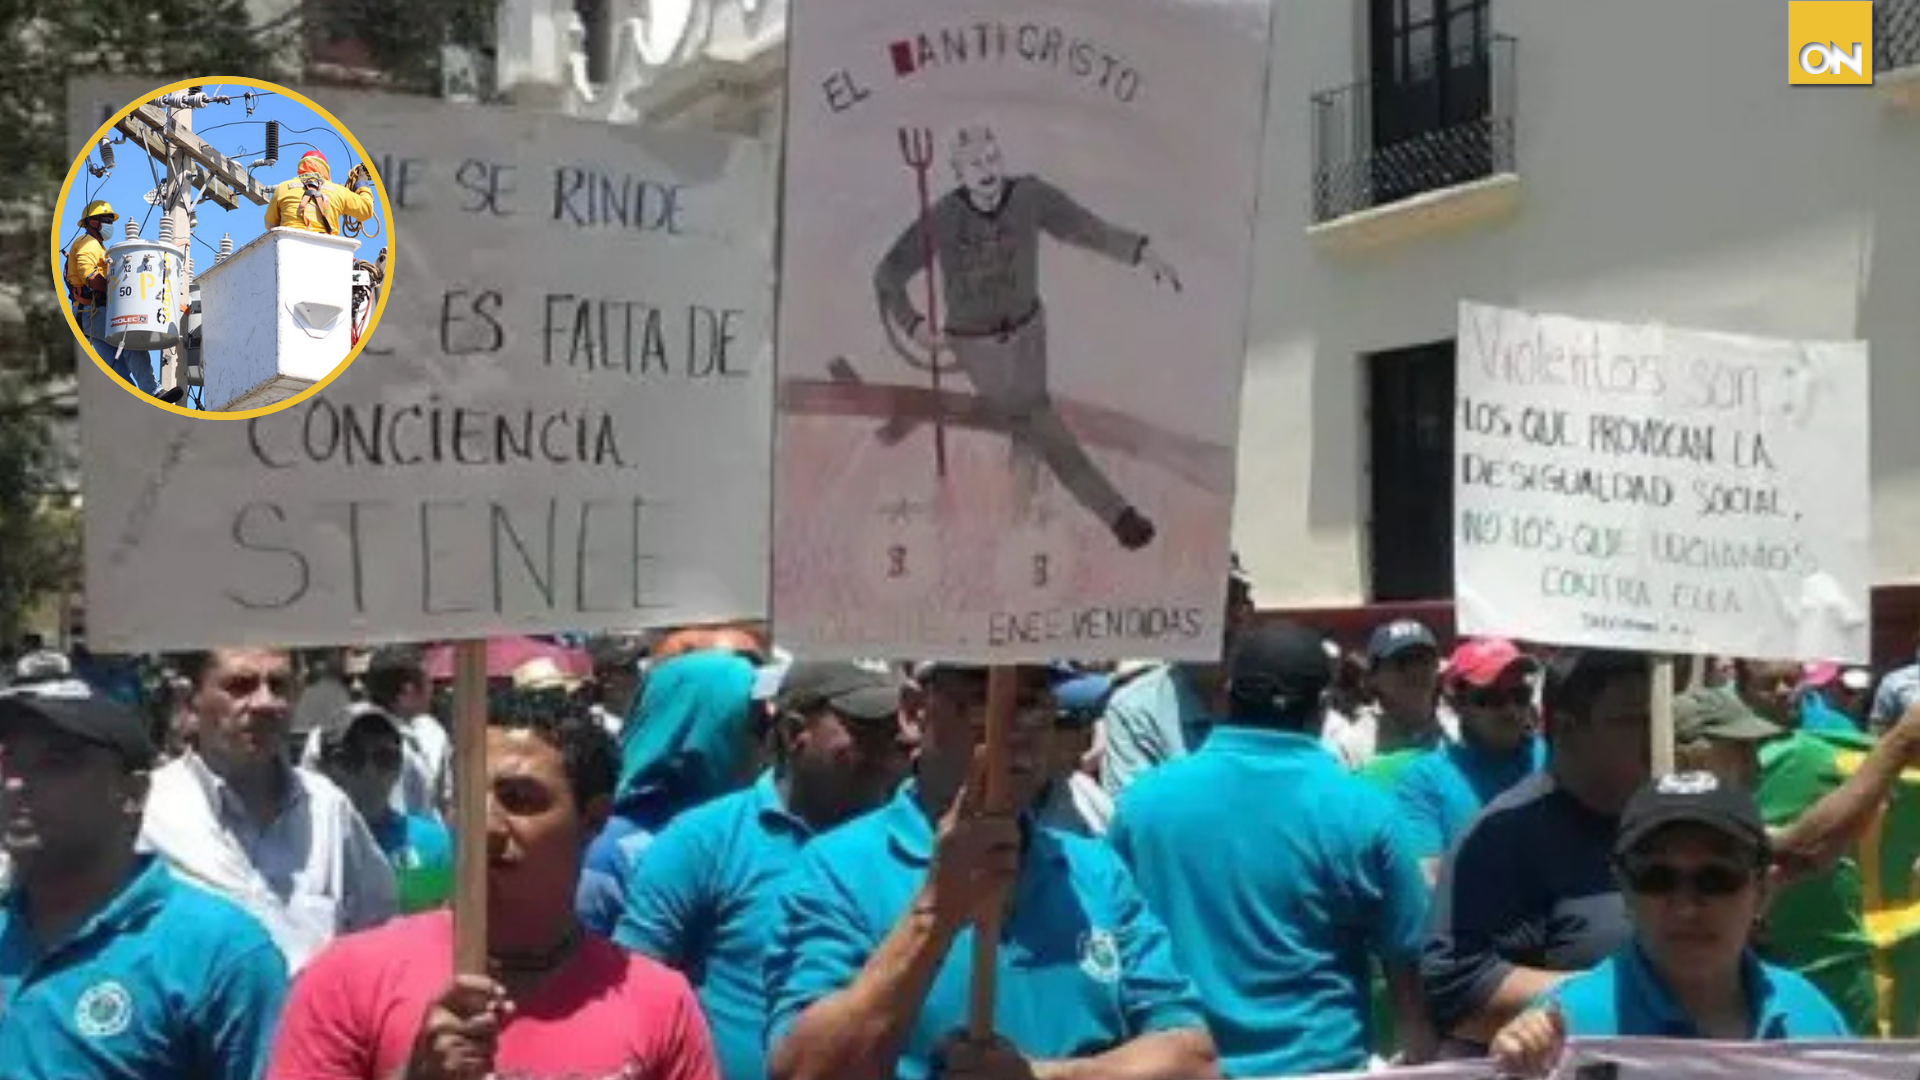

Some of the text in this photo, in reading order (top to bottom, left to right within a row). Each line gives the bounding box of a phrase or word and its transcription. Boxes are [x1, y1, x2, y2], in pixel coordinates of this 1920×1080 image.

[823, 71, 870, 112] EL
[455, 157, 518, 217] SE
[552, 163, 686, 235] RINDE
[119, 286, 132, 297] 50
[440, 288, 748, 378] ES FALTA DE
[1733, 428, 1775, 471] LA
[1461, 453, 1675, 508] DESIGUALDAD
[1462, 510, 1501, 547] NO
[225, 496, 680, 614] STENEE
